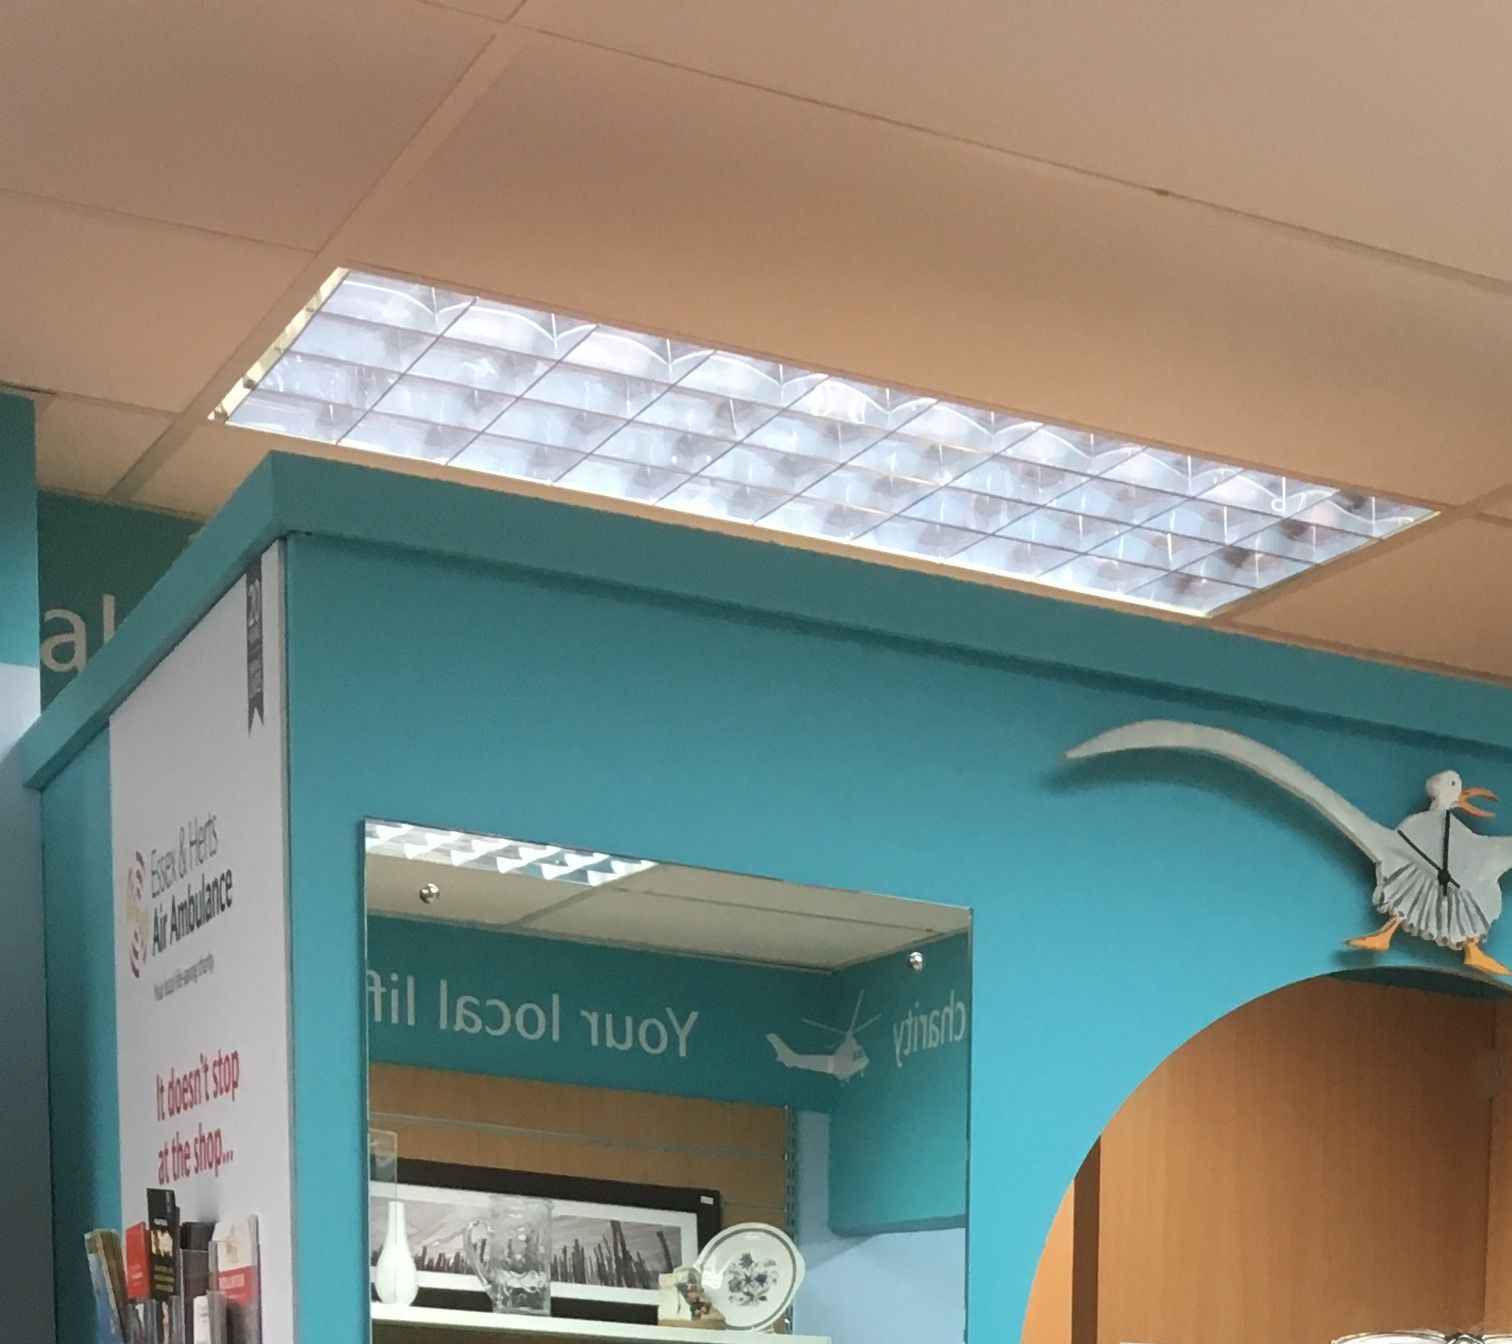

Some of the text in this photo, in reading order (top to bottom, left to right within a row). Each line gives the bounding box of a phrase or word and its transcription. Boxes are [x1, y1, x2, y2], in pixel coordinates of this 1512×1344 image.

[152, 869, 233, 957] Air Ambulance
[156, 1049, 240, 1122] It doesn't stop
[158, 1141, 169, 1185] at
[172, 1132, 190, 1181] the
